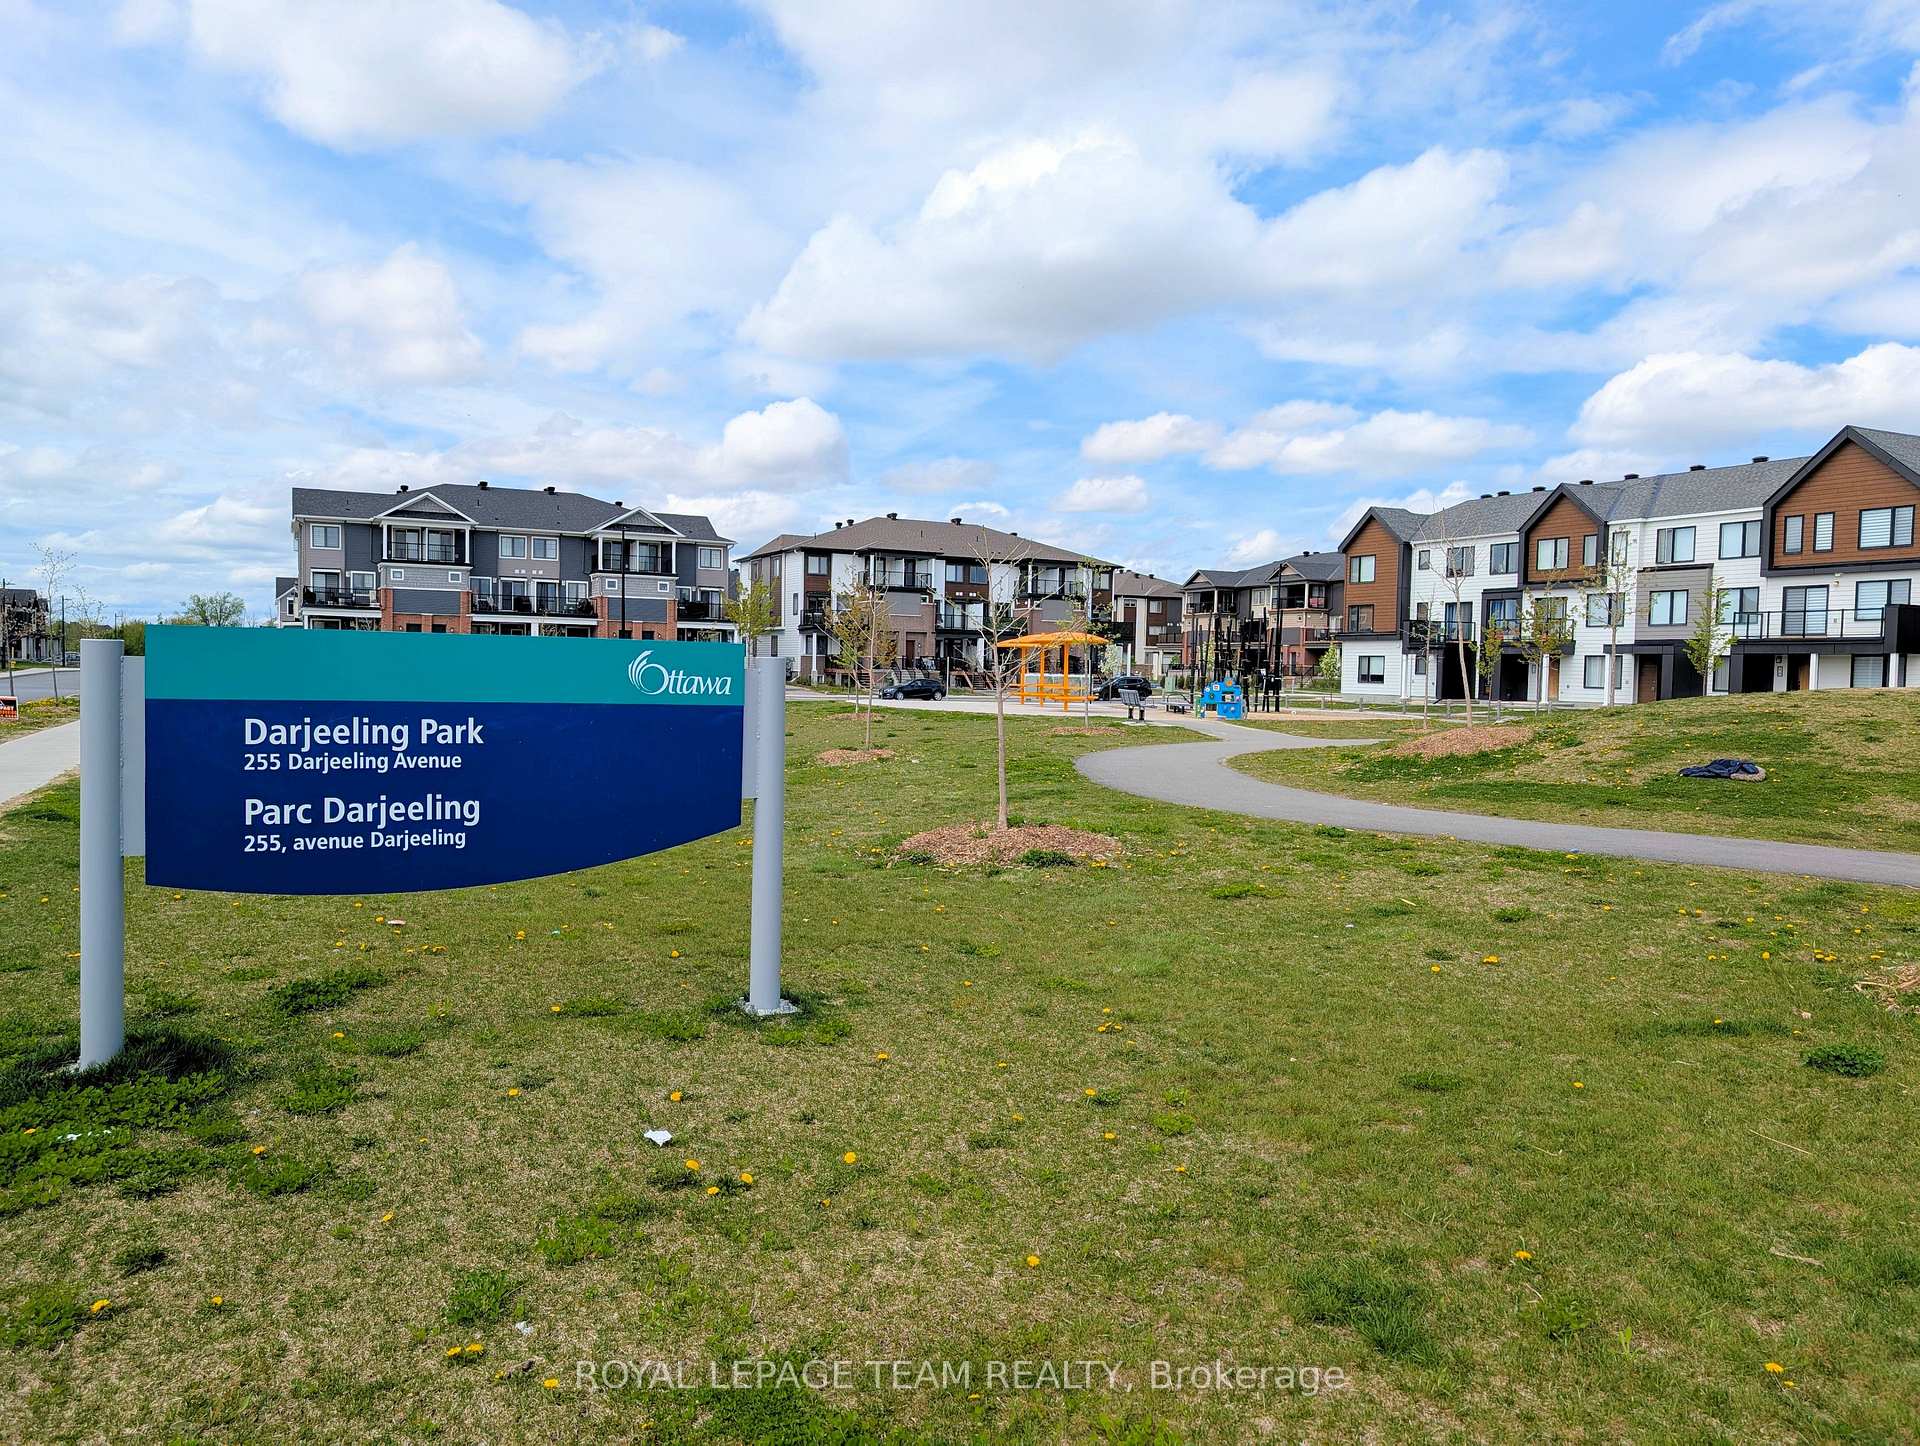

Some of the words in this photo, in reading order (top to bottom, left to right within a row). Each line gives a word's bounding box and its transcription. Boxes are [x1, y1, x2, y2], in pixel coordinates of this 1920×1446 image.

[629, 650, 732, 695] Ottawa
[244, 716, 409, 752] Darjeeling
[421, 717, 484, 745] Park
[244, 753, 281, 771] 255
[288, 751, 389, 774] Darjeeling
[393, 752, 462, 769] Avenue
[245, 798, 312, 826] Parc
[324, 793, 480, 829] Darjeeling
[244, 834, 287, 854] 255,
[293, 836, 364, 851] avenue
[370, 828, 466, 851] Darjeeling
